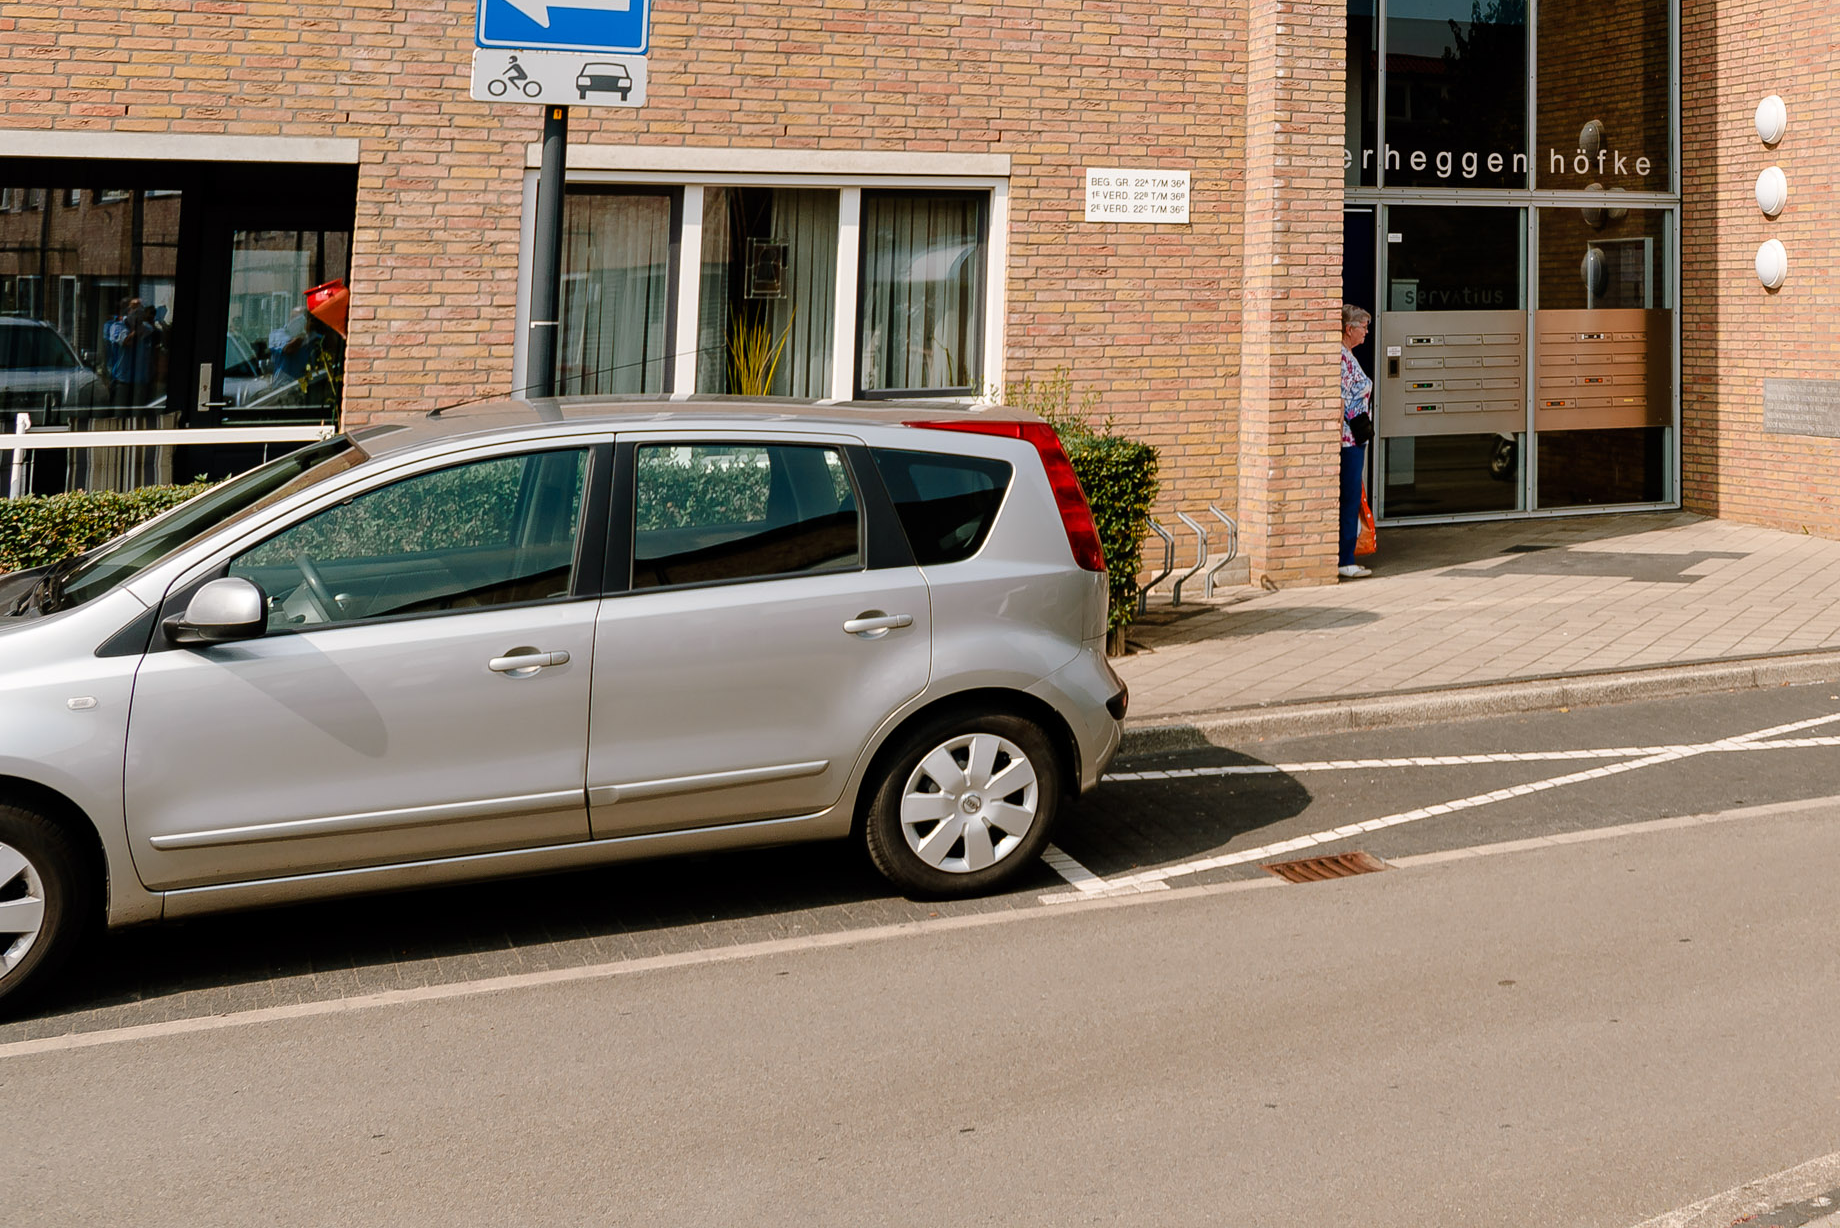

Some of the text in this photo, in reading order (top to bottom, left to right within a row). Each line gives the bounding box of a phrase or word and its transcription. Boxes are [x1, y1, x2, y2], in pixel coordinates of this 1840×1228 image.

[1550, 148, 1651, 175] höfke
[1091, 177, 1112, 187] BEG.
[1115, 178, 1131, 187] GR.
[1152, 179, 1168, 188] T/M
[1103, 191, 1131, 200] VERD.
[1151, 192, 1168, 201] T/M
[1103, 204, 1131, 213] VERD.
[1151, 205, 1168, 214] T/M
